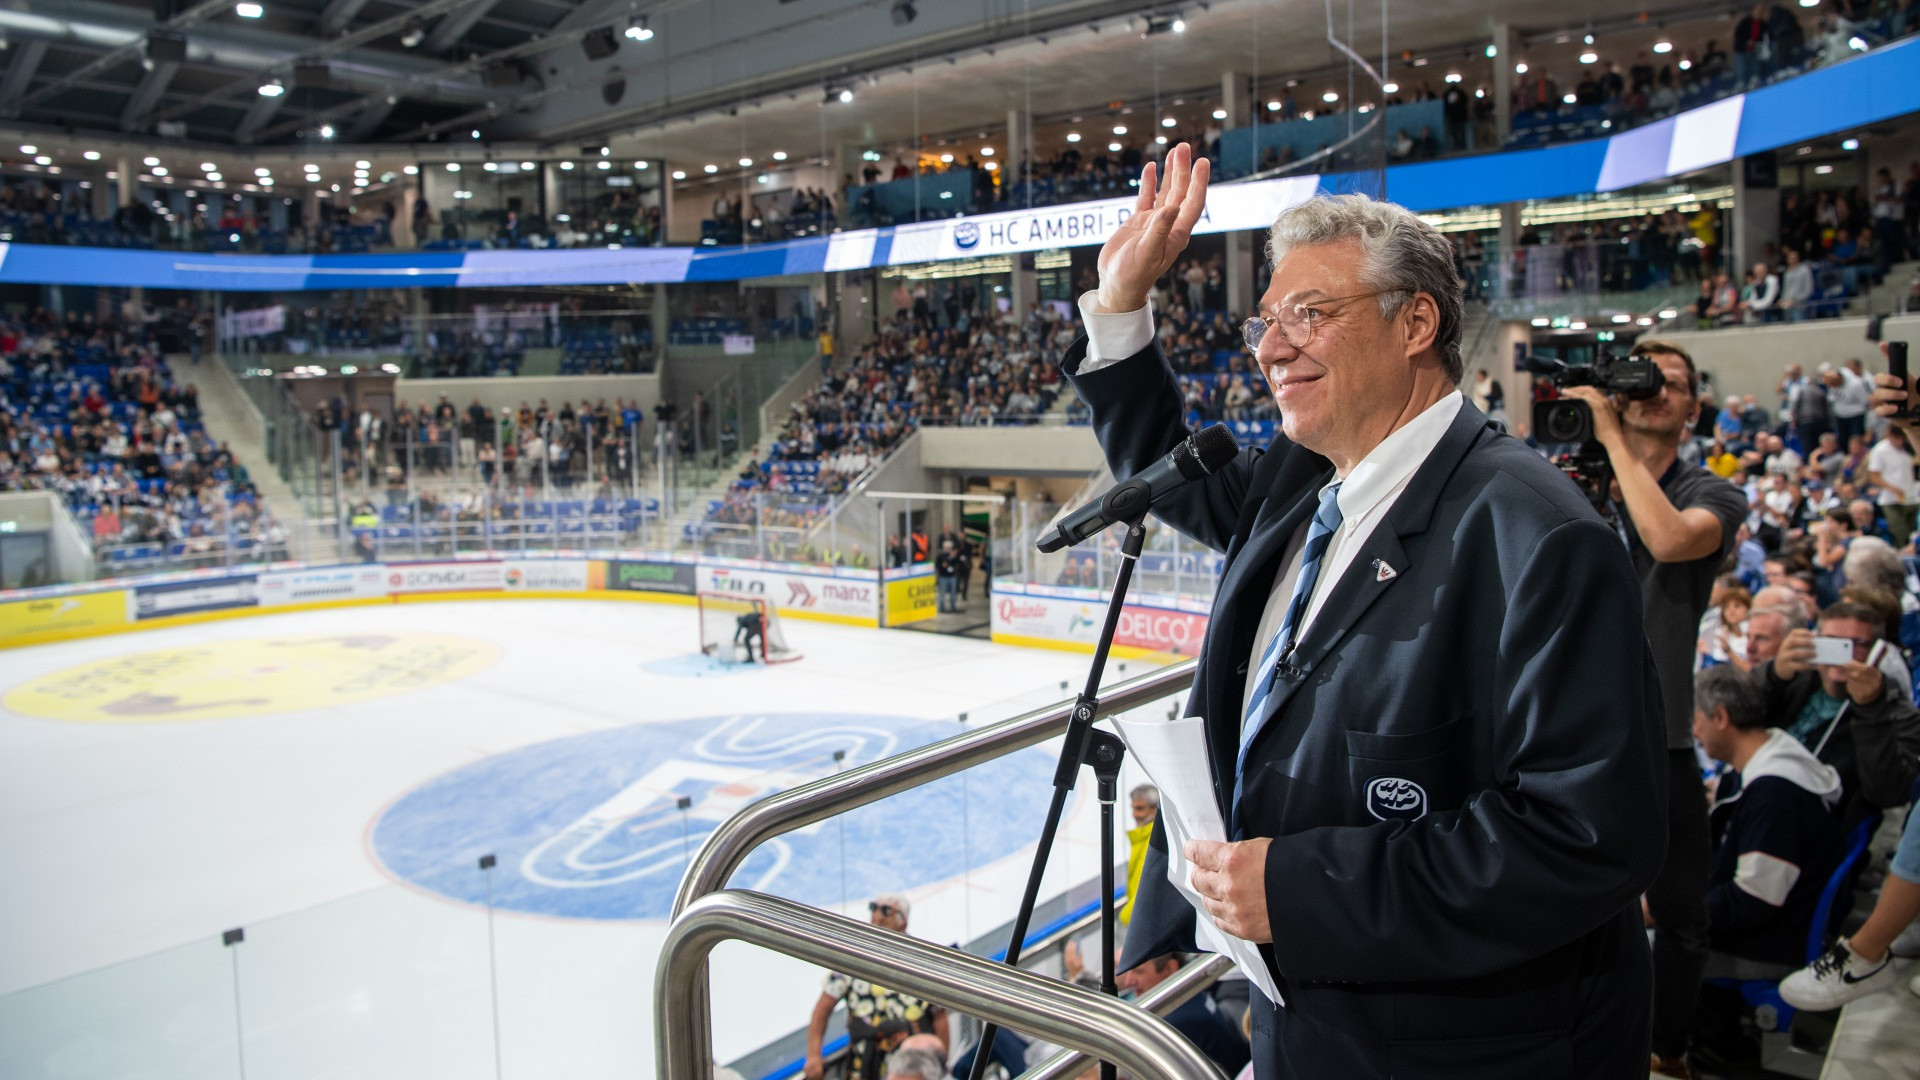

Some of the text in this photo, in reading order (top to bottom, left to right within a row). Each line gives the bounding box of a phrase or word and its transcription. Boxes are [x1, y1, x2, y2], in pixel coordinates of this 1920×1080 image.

[990, 221, 1018, 246] HC
[823, 584, 870, 603] manz
[997, 598, 1048, 625] Quinto
[1118, 612, 1191, 646] DELCO
